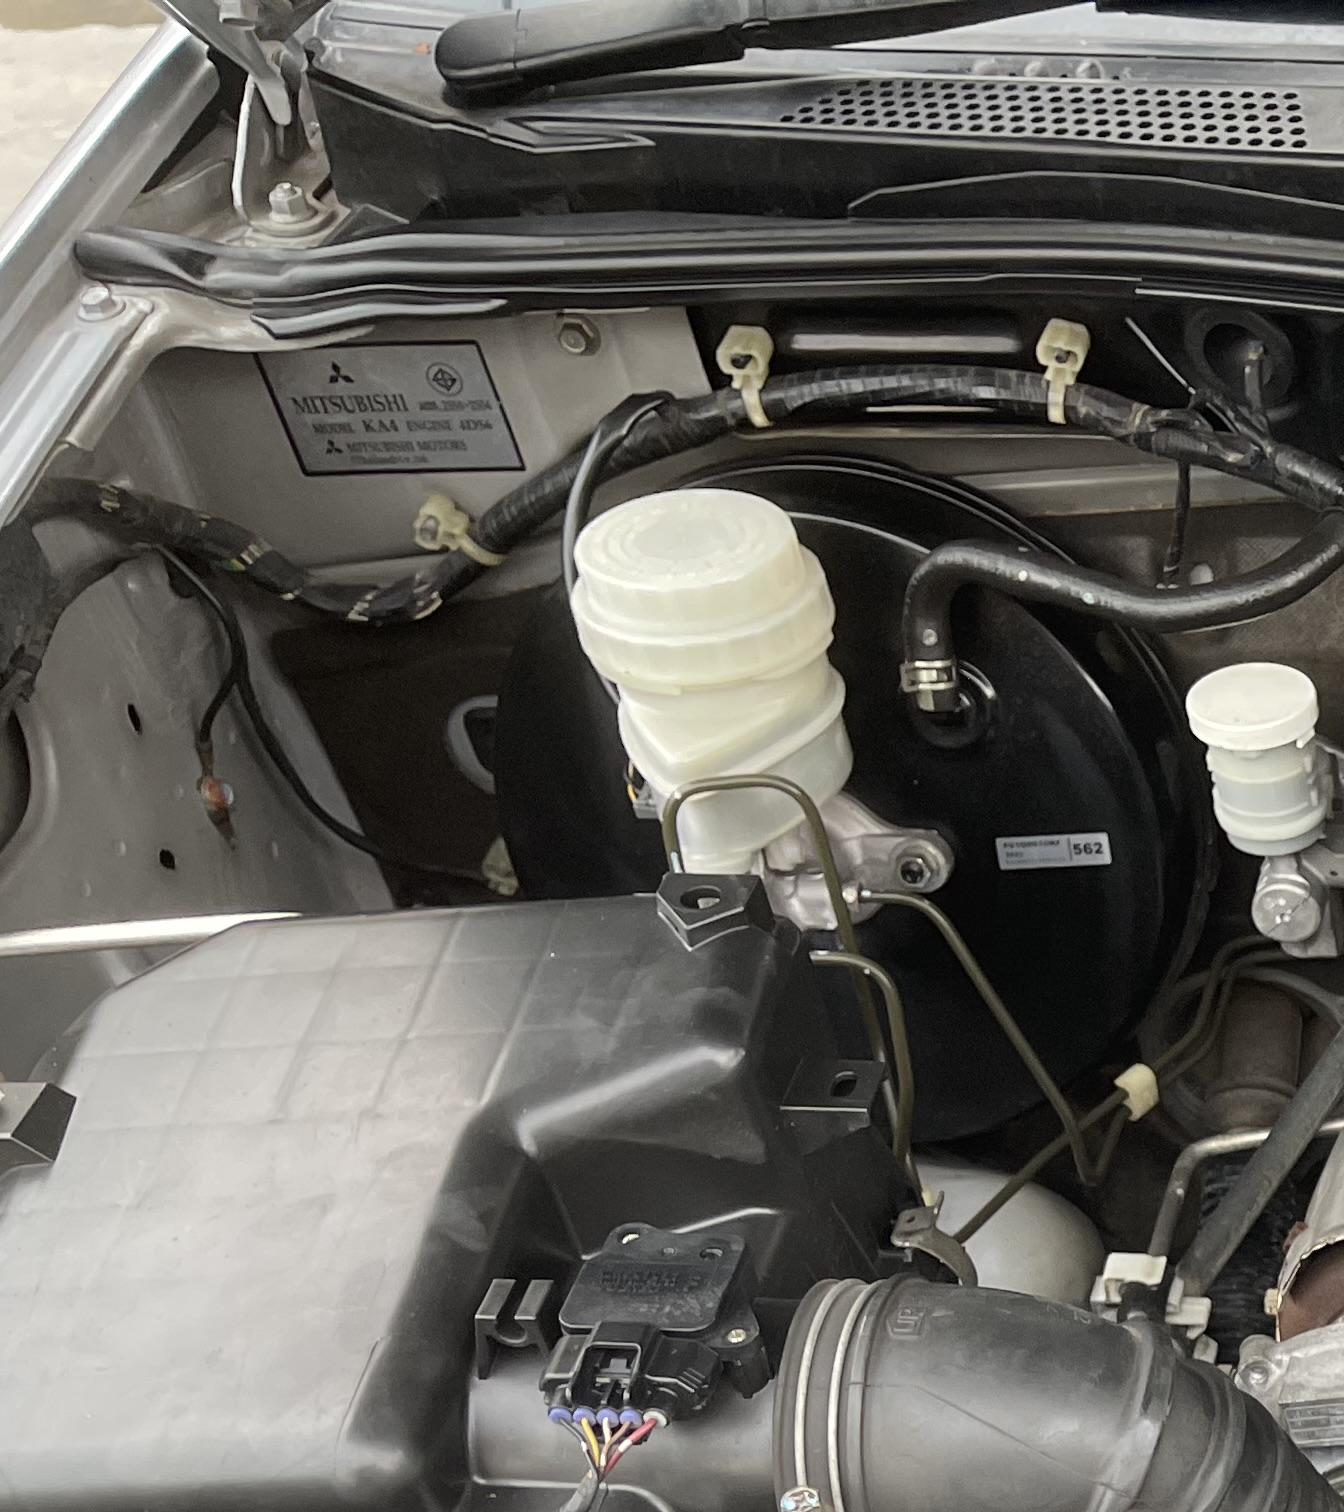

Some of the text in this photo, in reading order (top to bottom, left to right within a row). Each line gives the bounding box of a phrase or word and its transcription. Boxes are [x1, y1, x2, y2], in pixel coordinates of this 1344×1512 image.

[292, 394, 409, 415] MITSUBISHI
[312, 421, 355, 434] MODEL
[362, 418, 400, 433] KA4
[405, 420, 452, 432] ENGINE
[346, 439, 468, 453] MITSUBISHI MOTORS
[1073, 842, 1104, 855] 562
